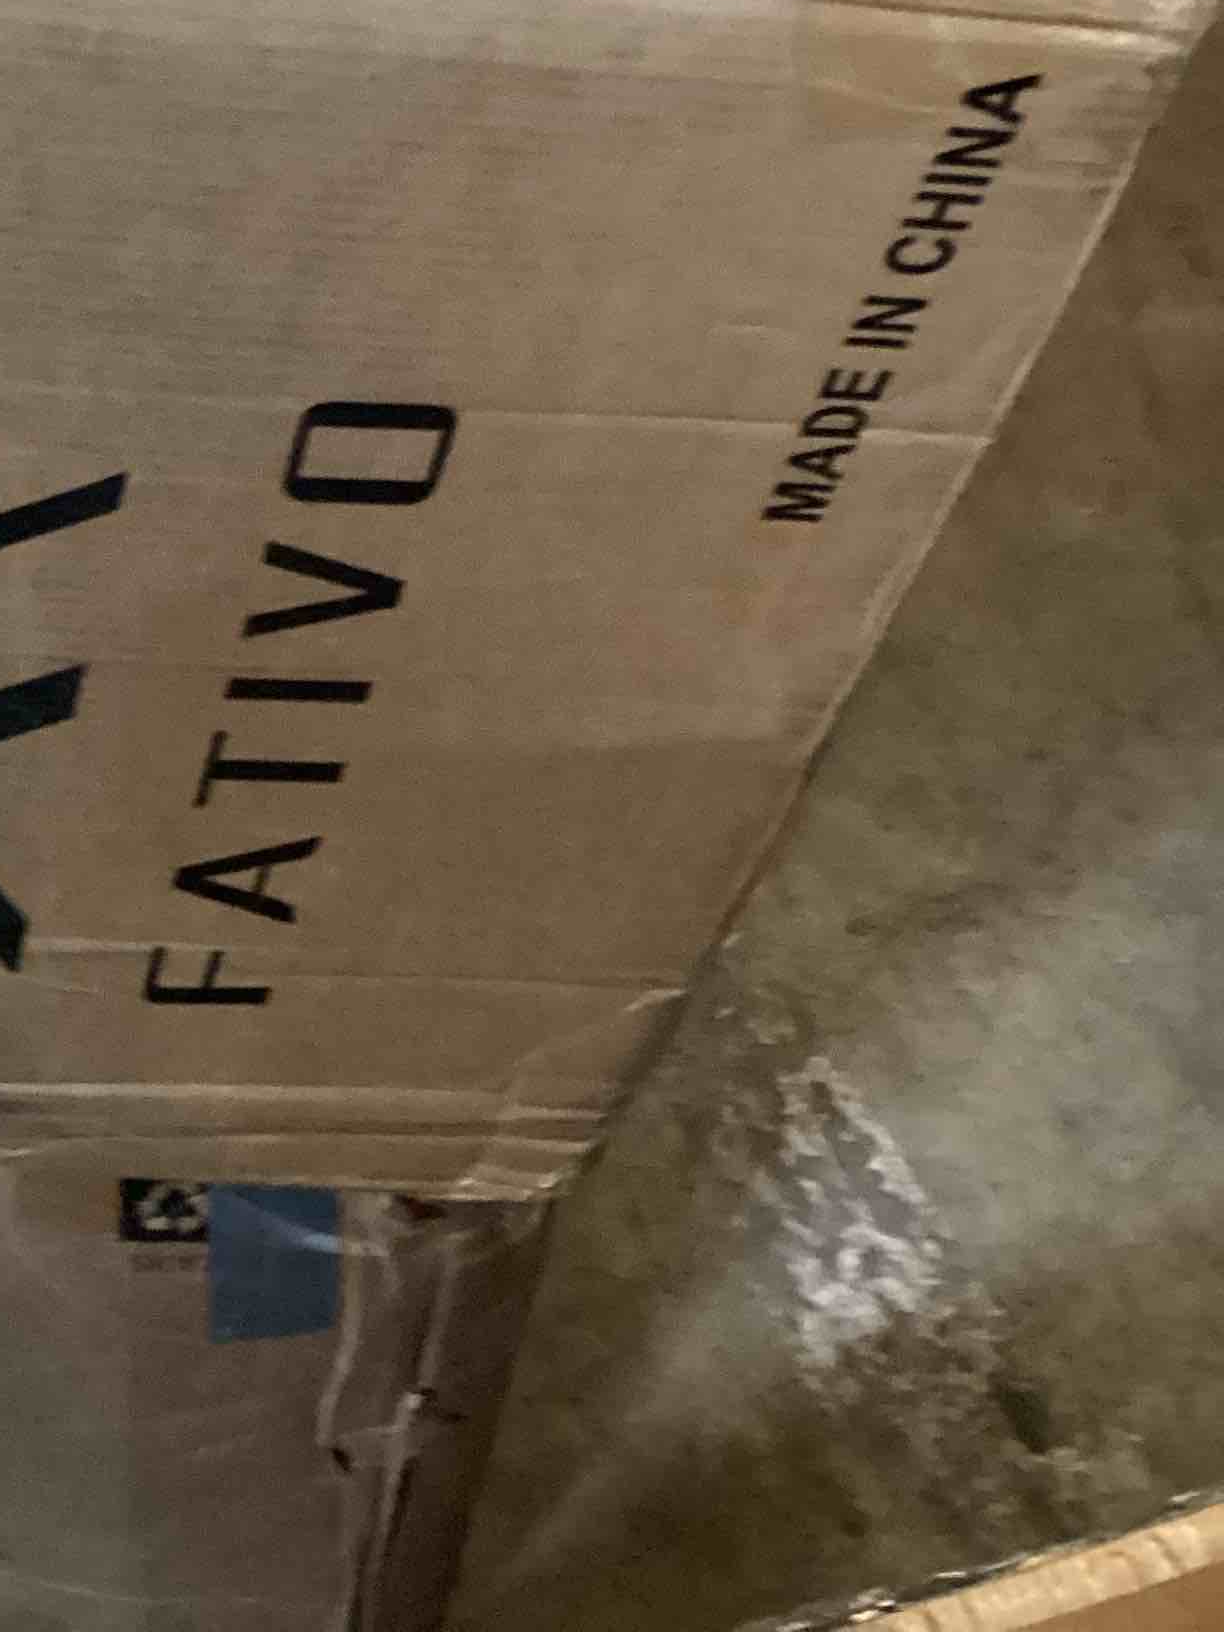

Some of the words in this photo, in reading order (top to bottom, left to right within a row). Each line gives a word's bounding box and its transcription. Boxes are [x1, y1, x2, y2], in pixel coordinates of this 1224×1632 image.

[883, 72, 1042, 277] CHINA
[842, 294, 930, 352] IN
[760, 368, 894, 525] MADE
[140, 400, 458, 1007] FATIVO
